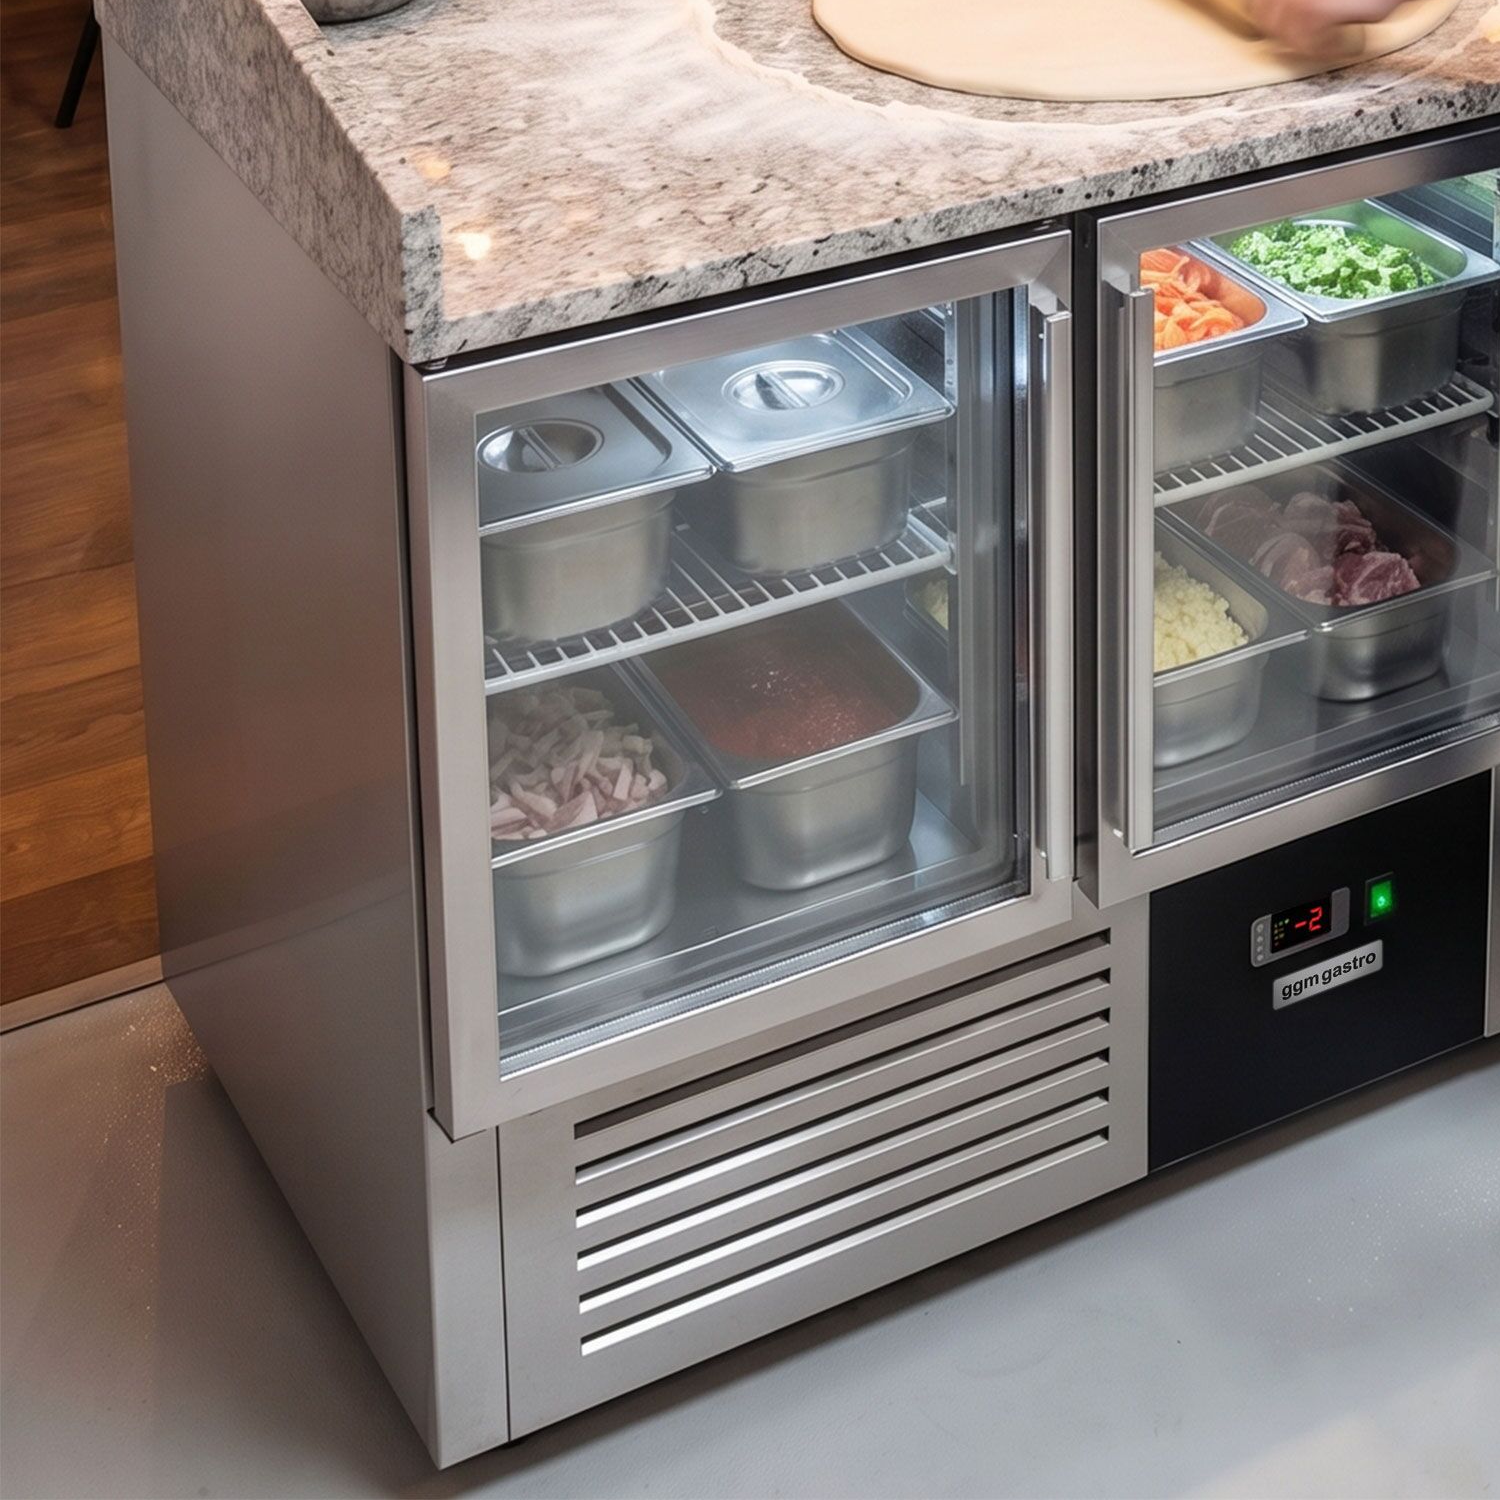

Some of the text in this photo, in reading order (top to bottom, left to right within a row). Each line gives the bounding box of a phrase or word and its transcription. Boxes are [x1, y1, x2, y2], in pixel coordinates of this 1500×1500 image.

[1295, 906, 1323, 931] -2
[1281, 952, 1376, 1000] ggm gastro
